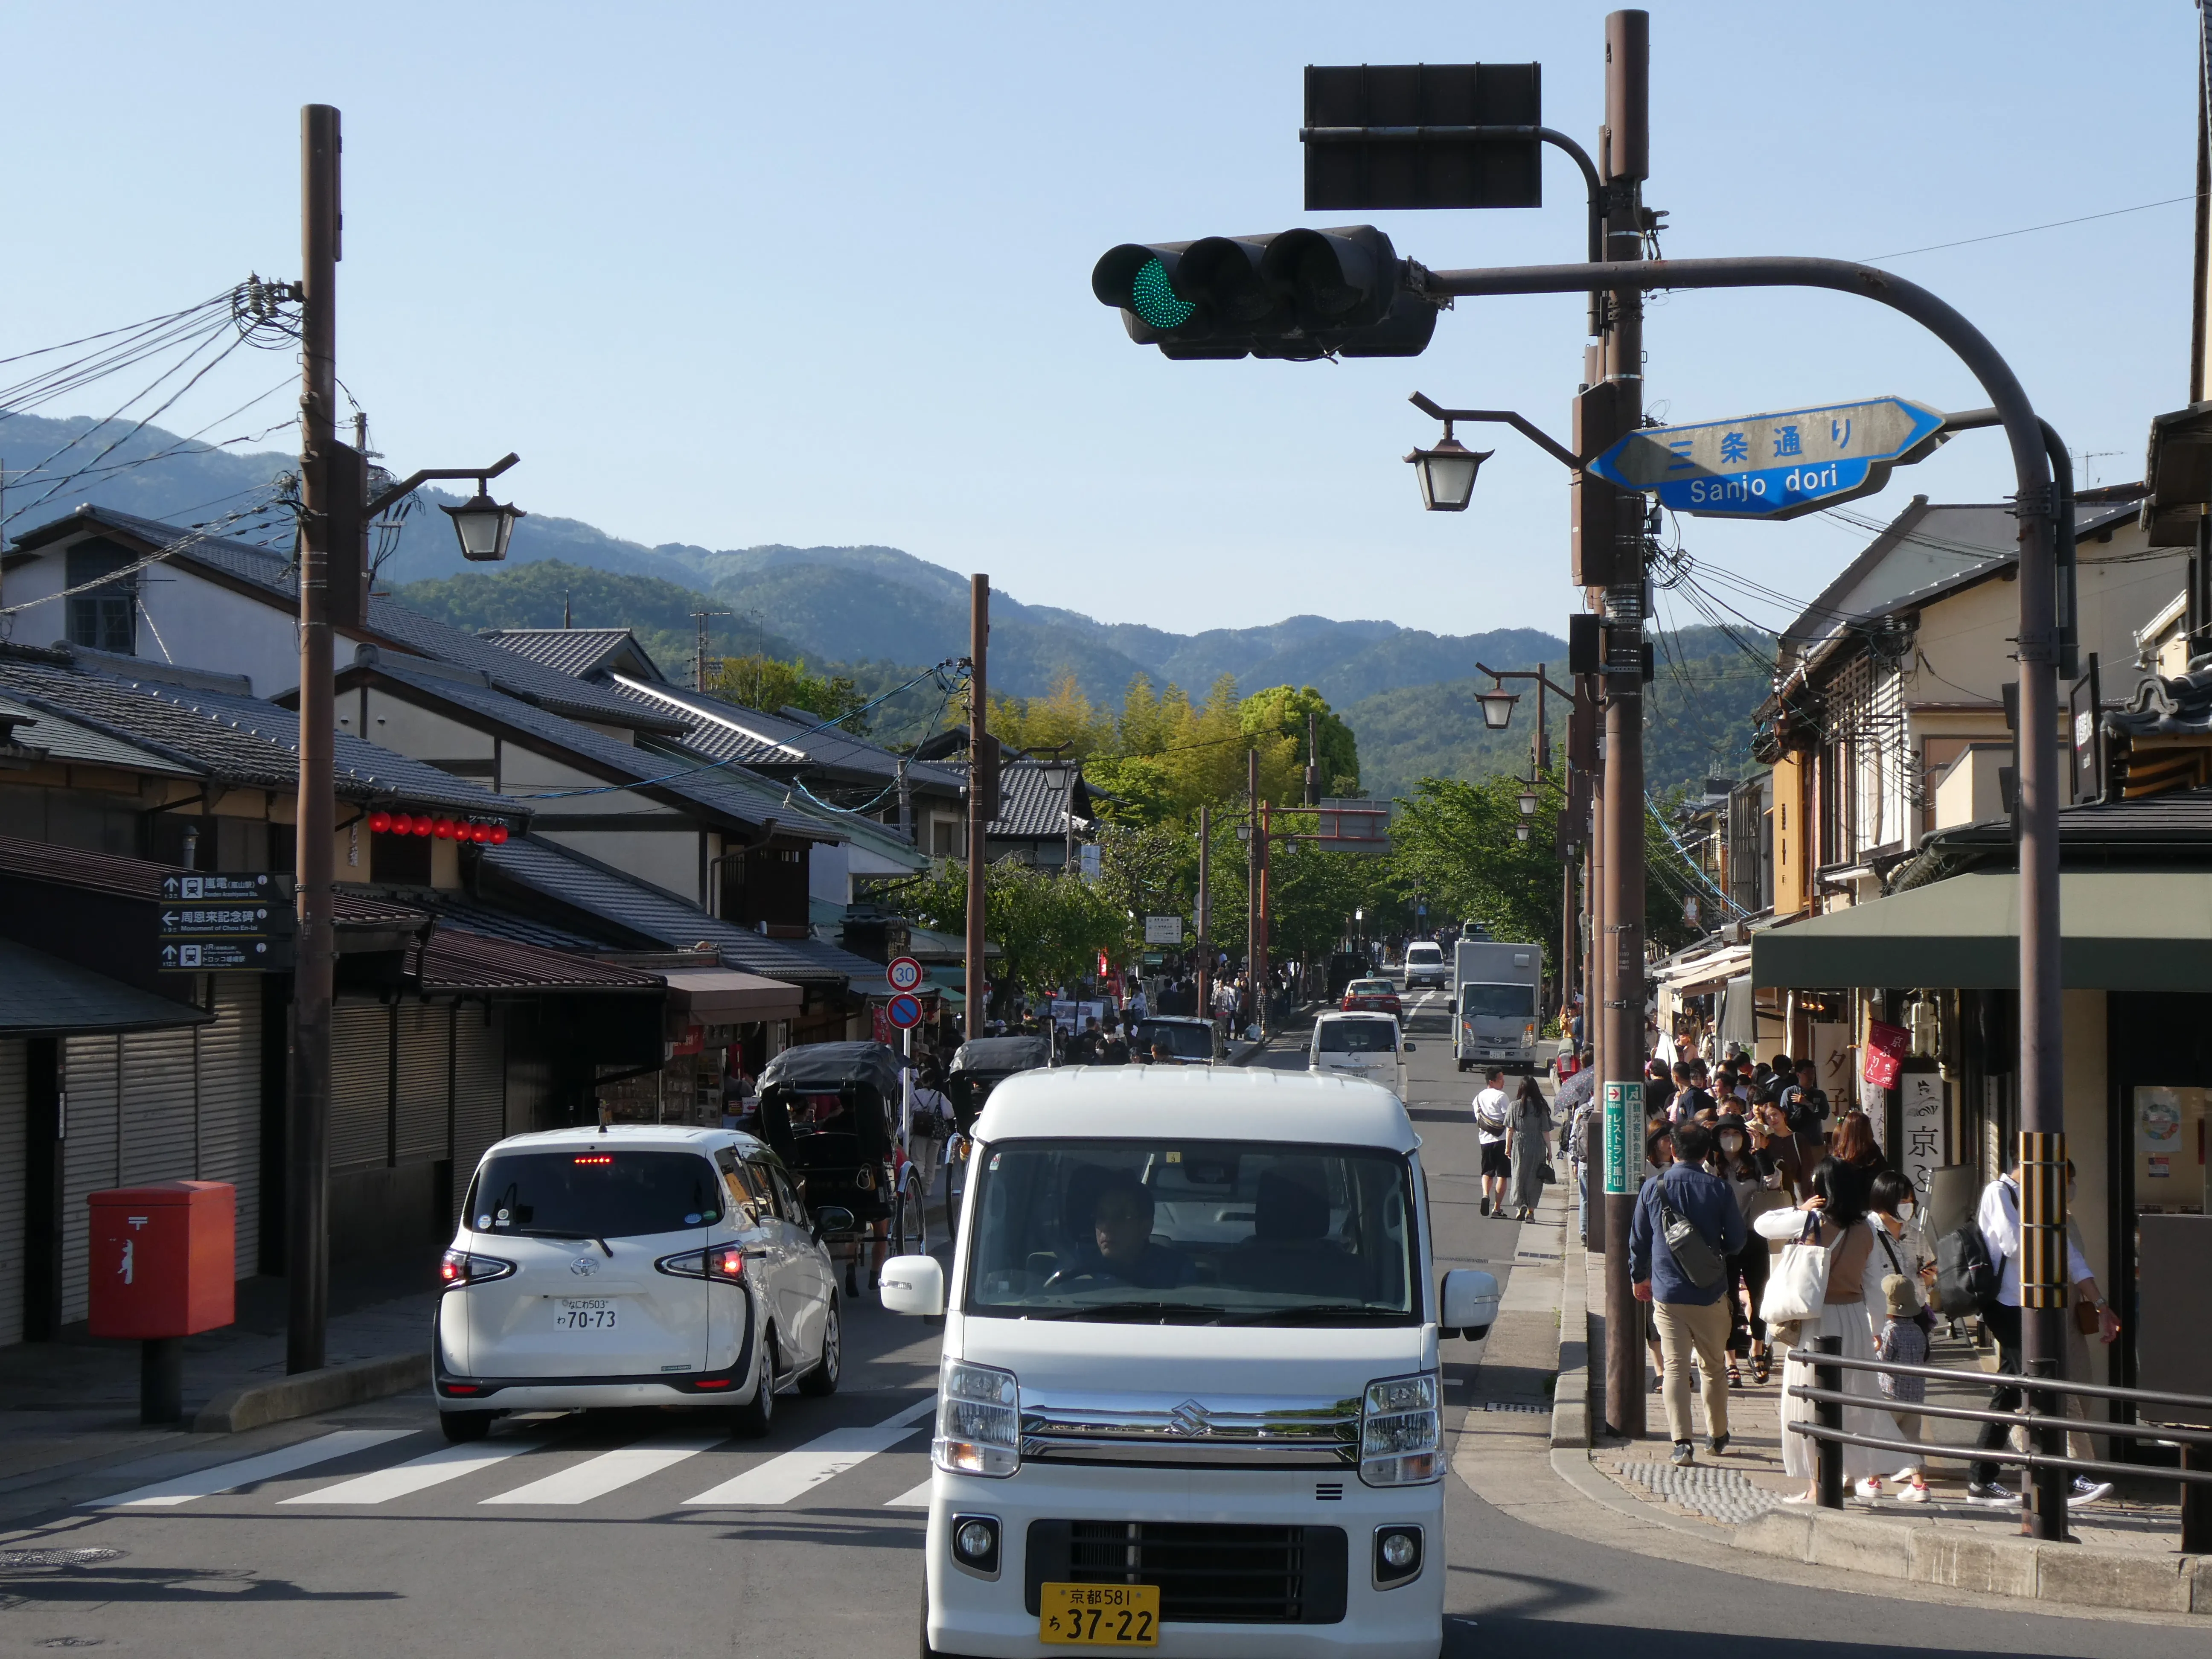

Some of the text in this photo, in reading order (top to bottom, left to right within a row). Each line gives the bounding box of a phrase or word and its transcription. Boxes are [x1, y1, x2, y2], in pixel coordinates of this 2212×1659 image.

[1668, 419, 1851, 470] 三条通り
[1691, 463, 1838, 503] Sanjo dori
[181, 911, 254, 923] 周恩来記念碑
[895, 967, 914, 983] 30
[1867, 1036, 1903, 1076] 京ぷりん
[1826, 1050, 1848, 1117] 夕子
[1613, 1113, 1623, 1186] レストラン嵐山
[557, 1311, 615, 1328] わ 70-73
[569, 1300, 605, 1309] なにわ503
[1070, 1589, 1129, 1605] 京都581
[1049, 1609, 1152, 1641] ち 37-22
